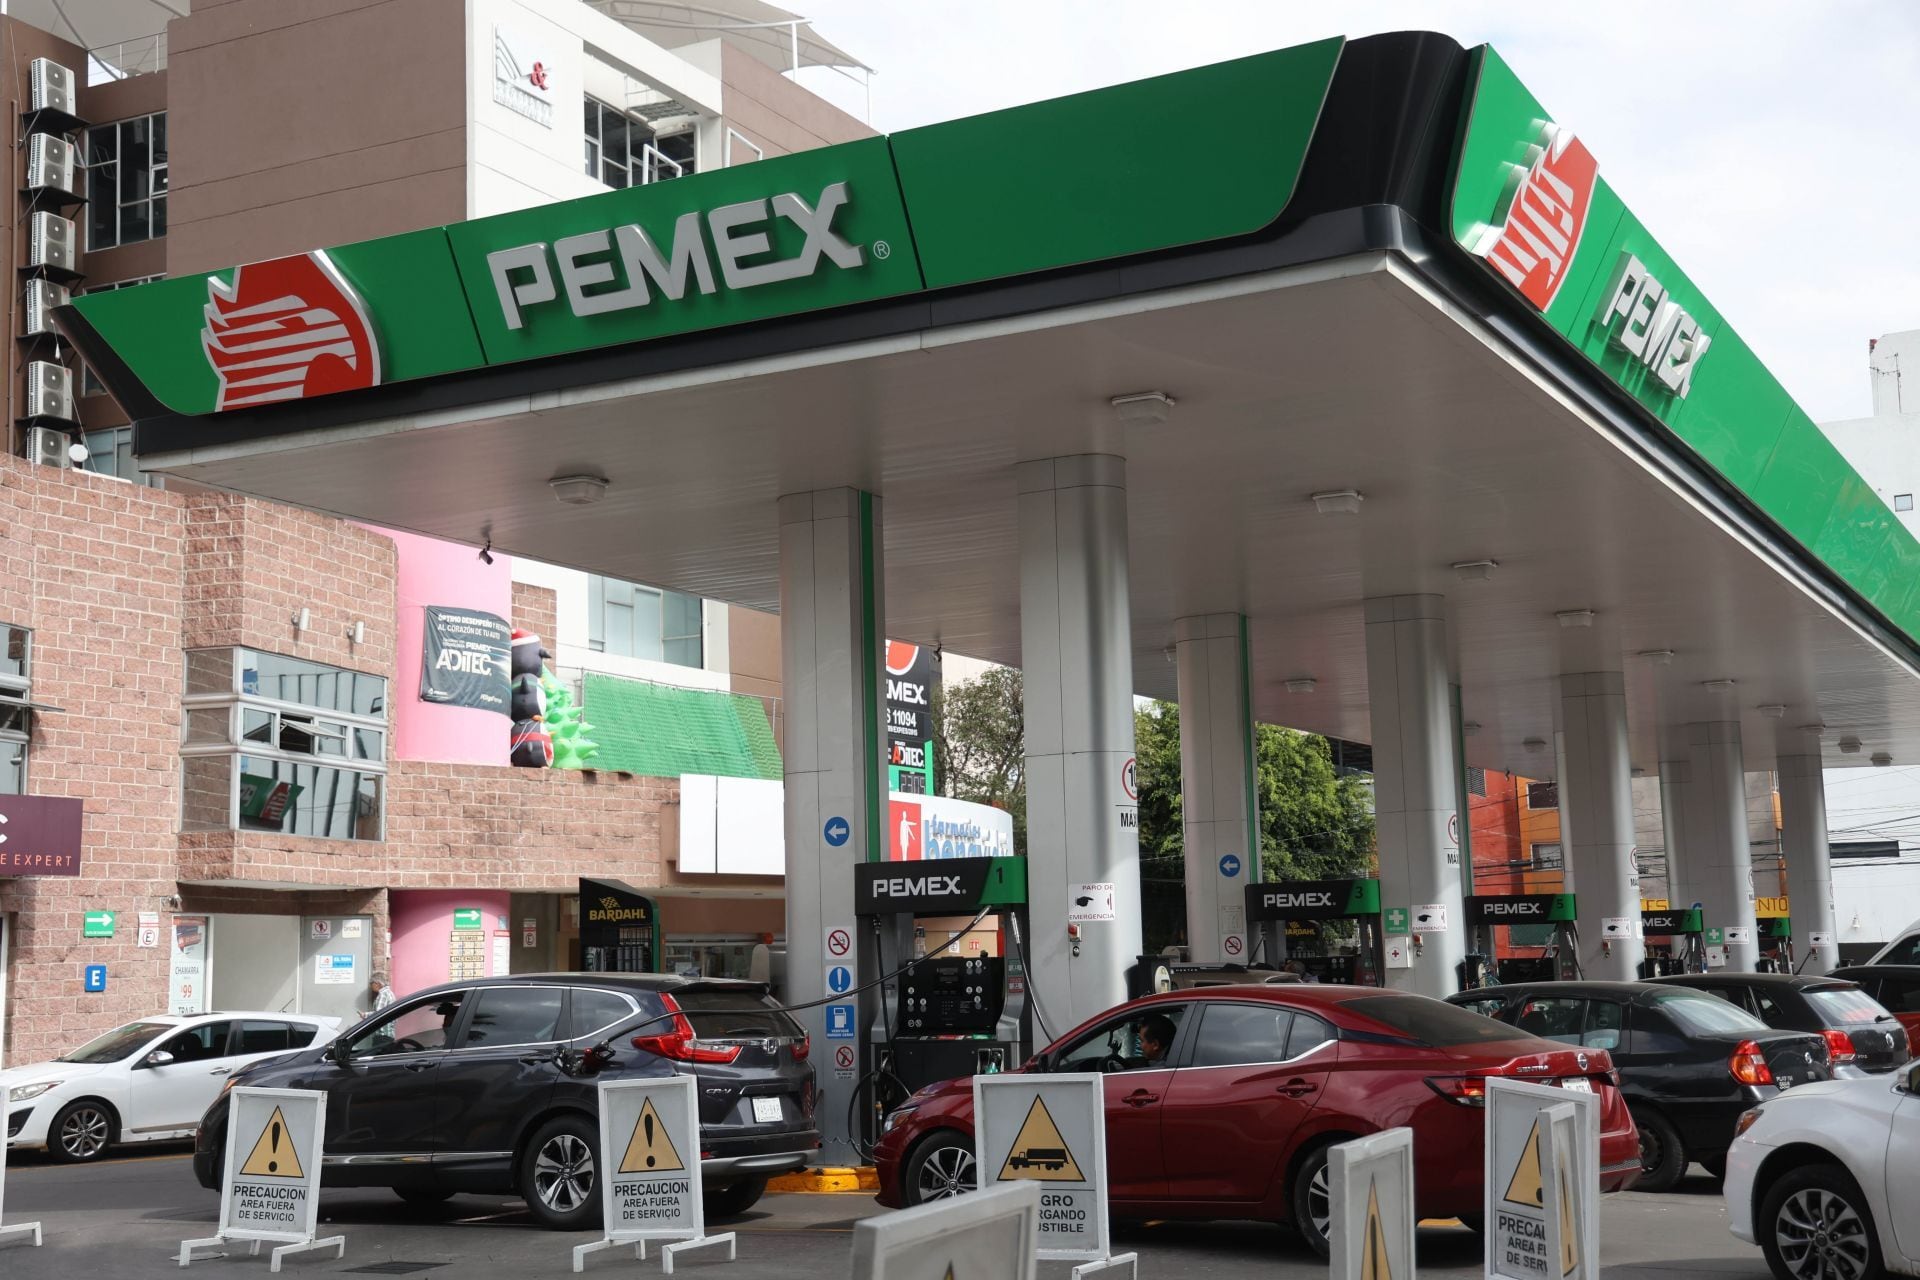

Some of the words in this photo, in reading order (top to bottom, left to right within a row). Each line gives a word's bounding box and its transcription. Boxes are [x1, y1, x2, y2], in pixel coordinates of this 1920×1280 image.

[486, 181, 866, 330] PEMEX
[1601, 253, 1712, 400] PEMEX
[438, 623, 446, 632] AL
[447, 624, 475, 634] CORAZÓN
[886, 679, 925, 705] MEX
[892, 709, 917, 728] 11094
[14, 853, 73, 867] EXPERT
[996, 866, 1004, 884] 1
[872, 876, 961, 898] PEMEX
[1354, 886, 1364, 899] 3
[1263, 892, 1332, 908] PEMEX
[1755, 897, 1788, 912] NTO
[589, 908, 647, 922] BARDAHL
[1483, 902, 1541, 915] PEMEX
[91, 969, 100, 986] E
[233, 1185, 306, 1200] PRECAUCION
[614, 1181, 689, 1197] PRECAUCION
[240, 1199, 264, 1209] AREA
[266, 1200, 295, 1210] FUERA
[623, 1198, 648, 1208] AREA
[650, 1196, 680, 1207] FUERA
[238, 1210, 250, 1219] DE
[252, 1210, 295, 1222] SERVICIO
[623, 1210, 635, 1219] DE
[637, 1208, 681, 1219] SERVICIO
[1507, 1236, 1535, 1254] AREA
[1506, 1251, 1520, 1266] DE
